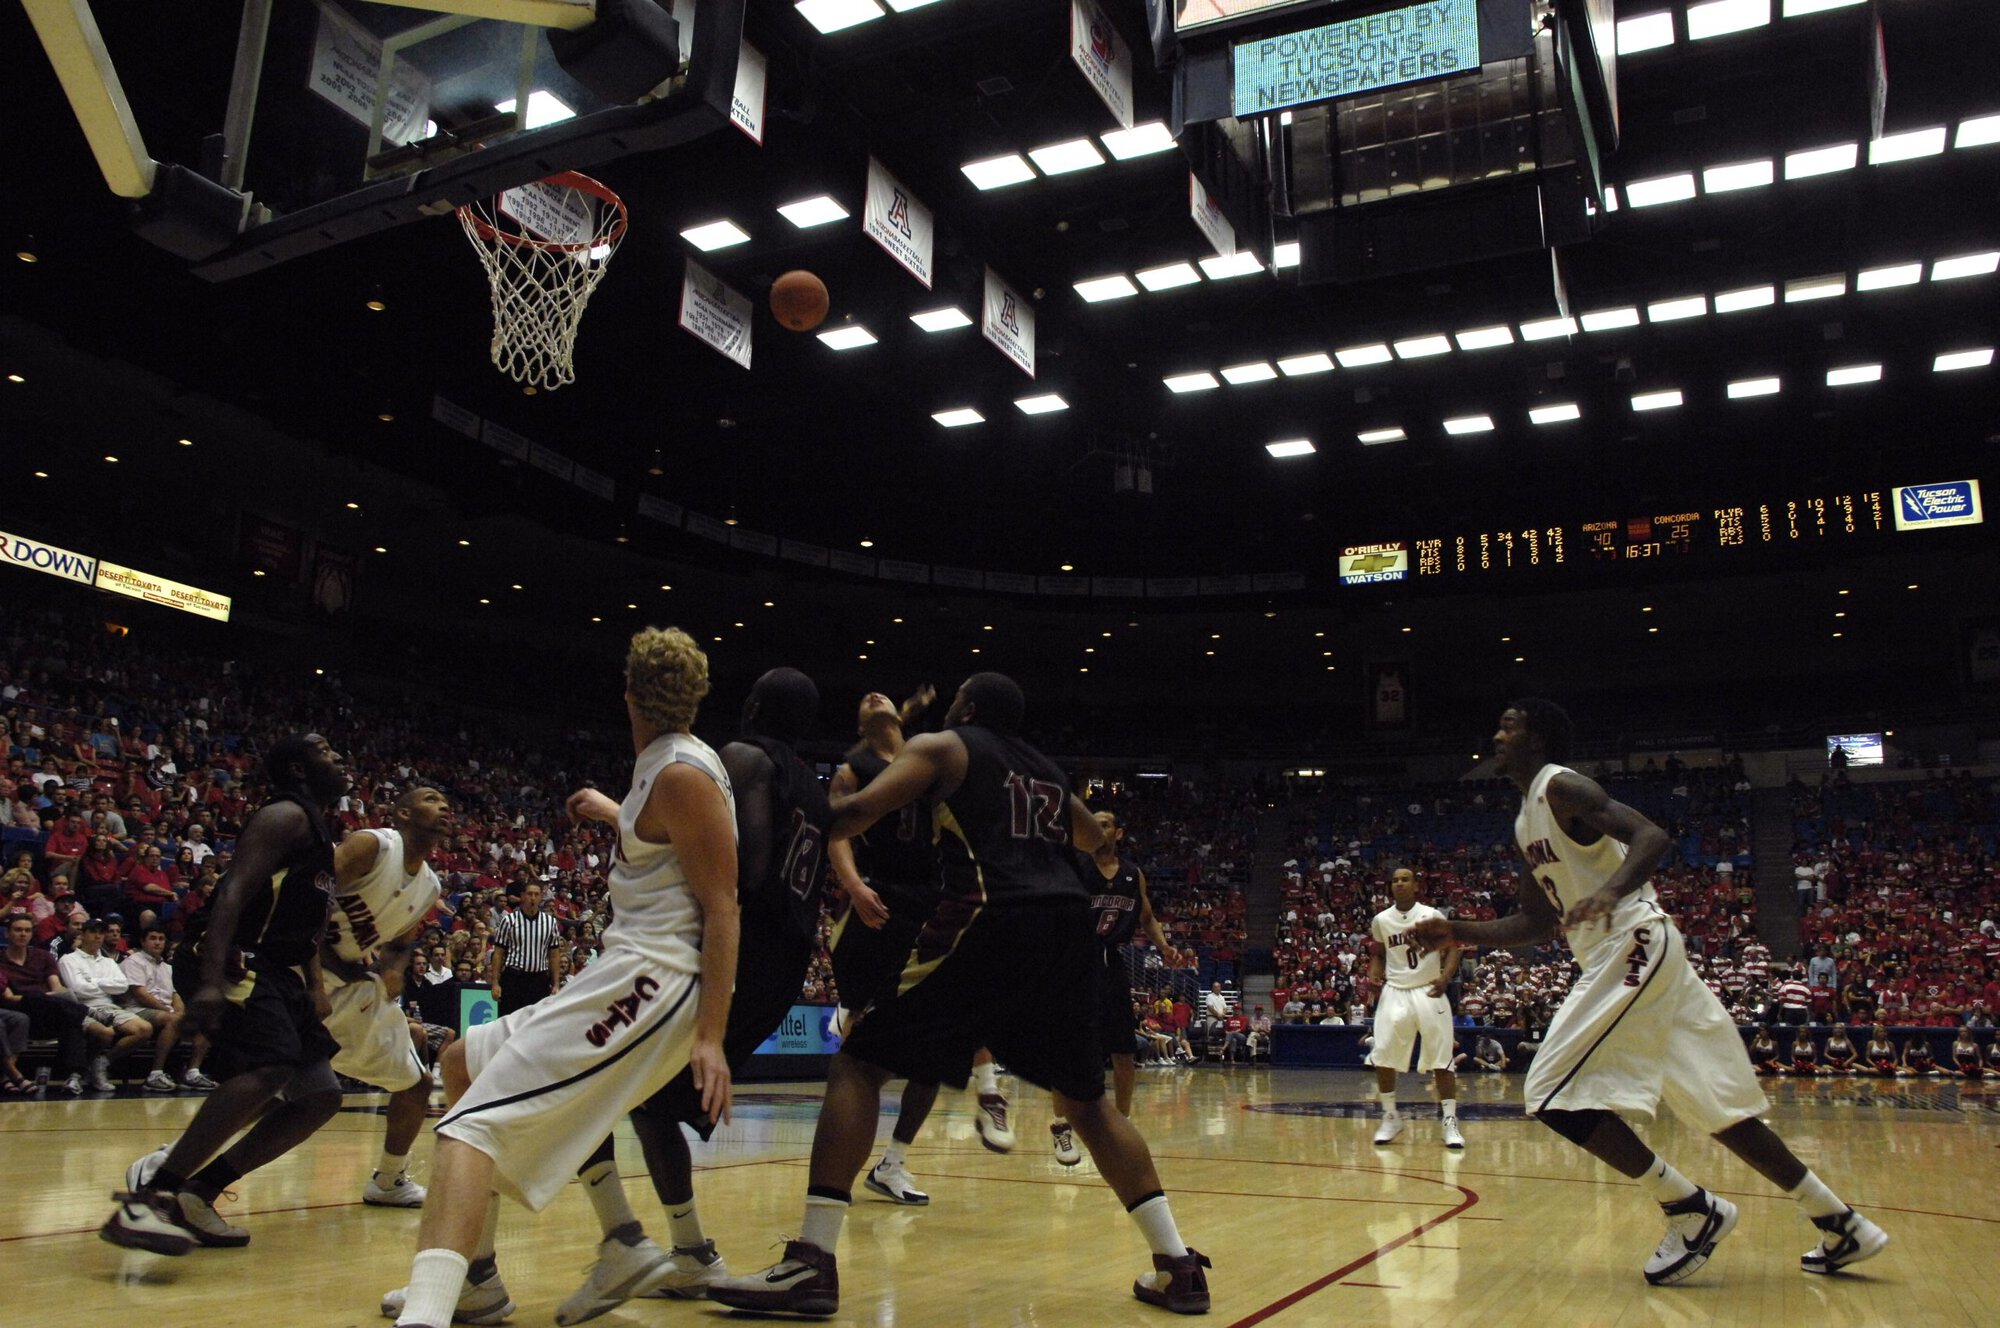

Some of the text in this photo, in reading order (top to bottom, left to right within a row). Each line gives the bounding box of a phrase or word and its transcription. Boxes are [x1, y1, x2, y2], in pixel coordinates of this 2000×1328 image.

[1260, 4, 1452, 63] POWERED BY
[1278, 32, 1424, 80] TUCSON'S
[1258, 48, 1460, 107] NEWSPAPERS
[888, 187, 911, 240] A
[885, 236, 902, 257] SWEET
[904, 254, 927, 278] SIXTEEN
[1001, 292, 1019, 337] A
[1916, 488, 1957, 499] Tucson
[1922, 494, 1966, 507] Electric
[1714, 507, 1744, 519] PLYR
[1760, 505, 1769, 514] 6
[1808, 498, 1824, 509] 10
[1863, 492, 1880, 502] 15
[1927, 503, 1967, 515] Power
[1582, 521, 1618, 532] ARIZONA
[1654, 512, 1700, 525] CONCORDIA
[1720, 517, 1741, 528] PTS
[1416, 527, 1563, 550] PLYR 0 5 34 42 43
[1594, 532, 1612, 545] 40
[1671, 525, 1690, 538] 25
[1719, 526, 1744, 537] RBS
[1762, 532, 1772, 542] 0
[1790, 529, 1799, 539] 0
[1845, 523, 1855, 533] 0
[1344, 542, 1401, 556] O'RIELLY
[1421, 548, 1439, 558] PTS
[1626, 543, 1660, 558] 16:37
[14, 541, 93, 581] DOWN
[1419, 557, 1441, 567] RBS
[1457, 562, 1466, 572] 0
[1481, 560, 1490, 569] 0
[1531, 556, 1539, 565] 0
[1556, 553, 1564, 563] 2
[99, 568, 162, 593] DESERT TOYOTA
[1345, 571, 1403, 585] WATSON
[171, 588, 199, 603] DESERT
[201, 597, 229, 612] TOYOTA
[1003, 769, 1069, 845] 12
[1407, 948, 1418, 970] 0
[1624, 928, 1650, 987] CATS
[585, 976, 660, 1047] CATS
